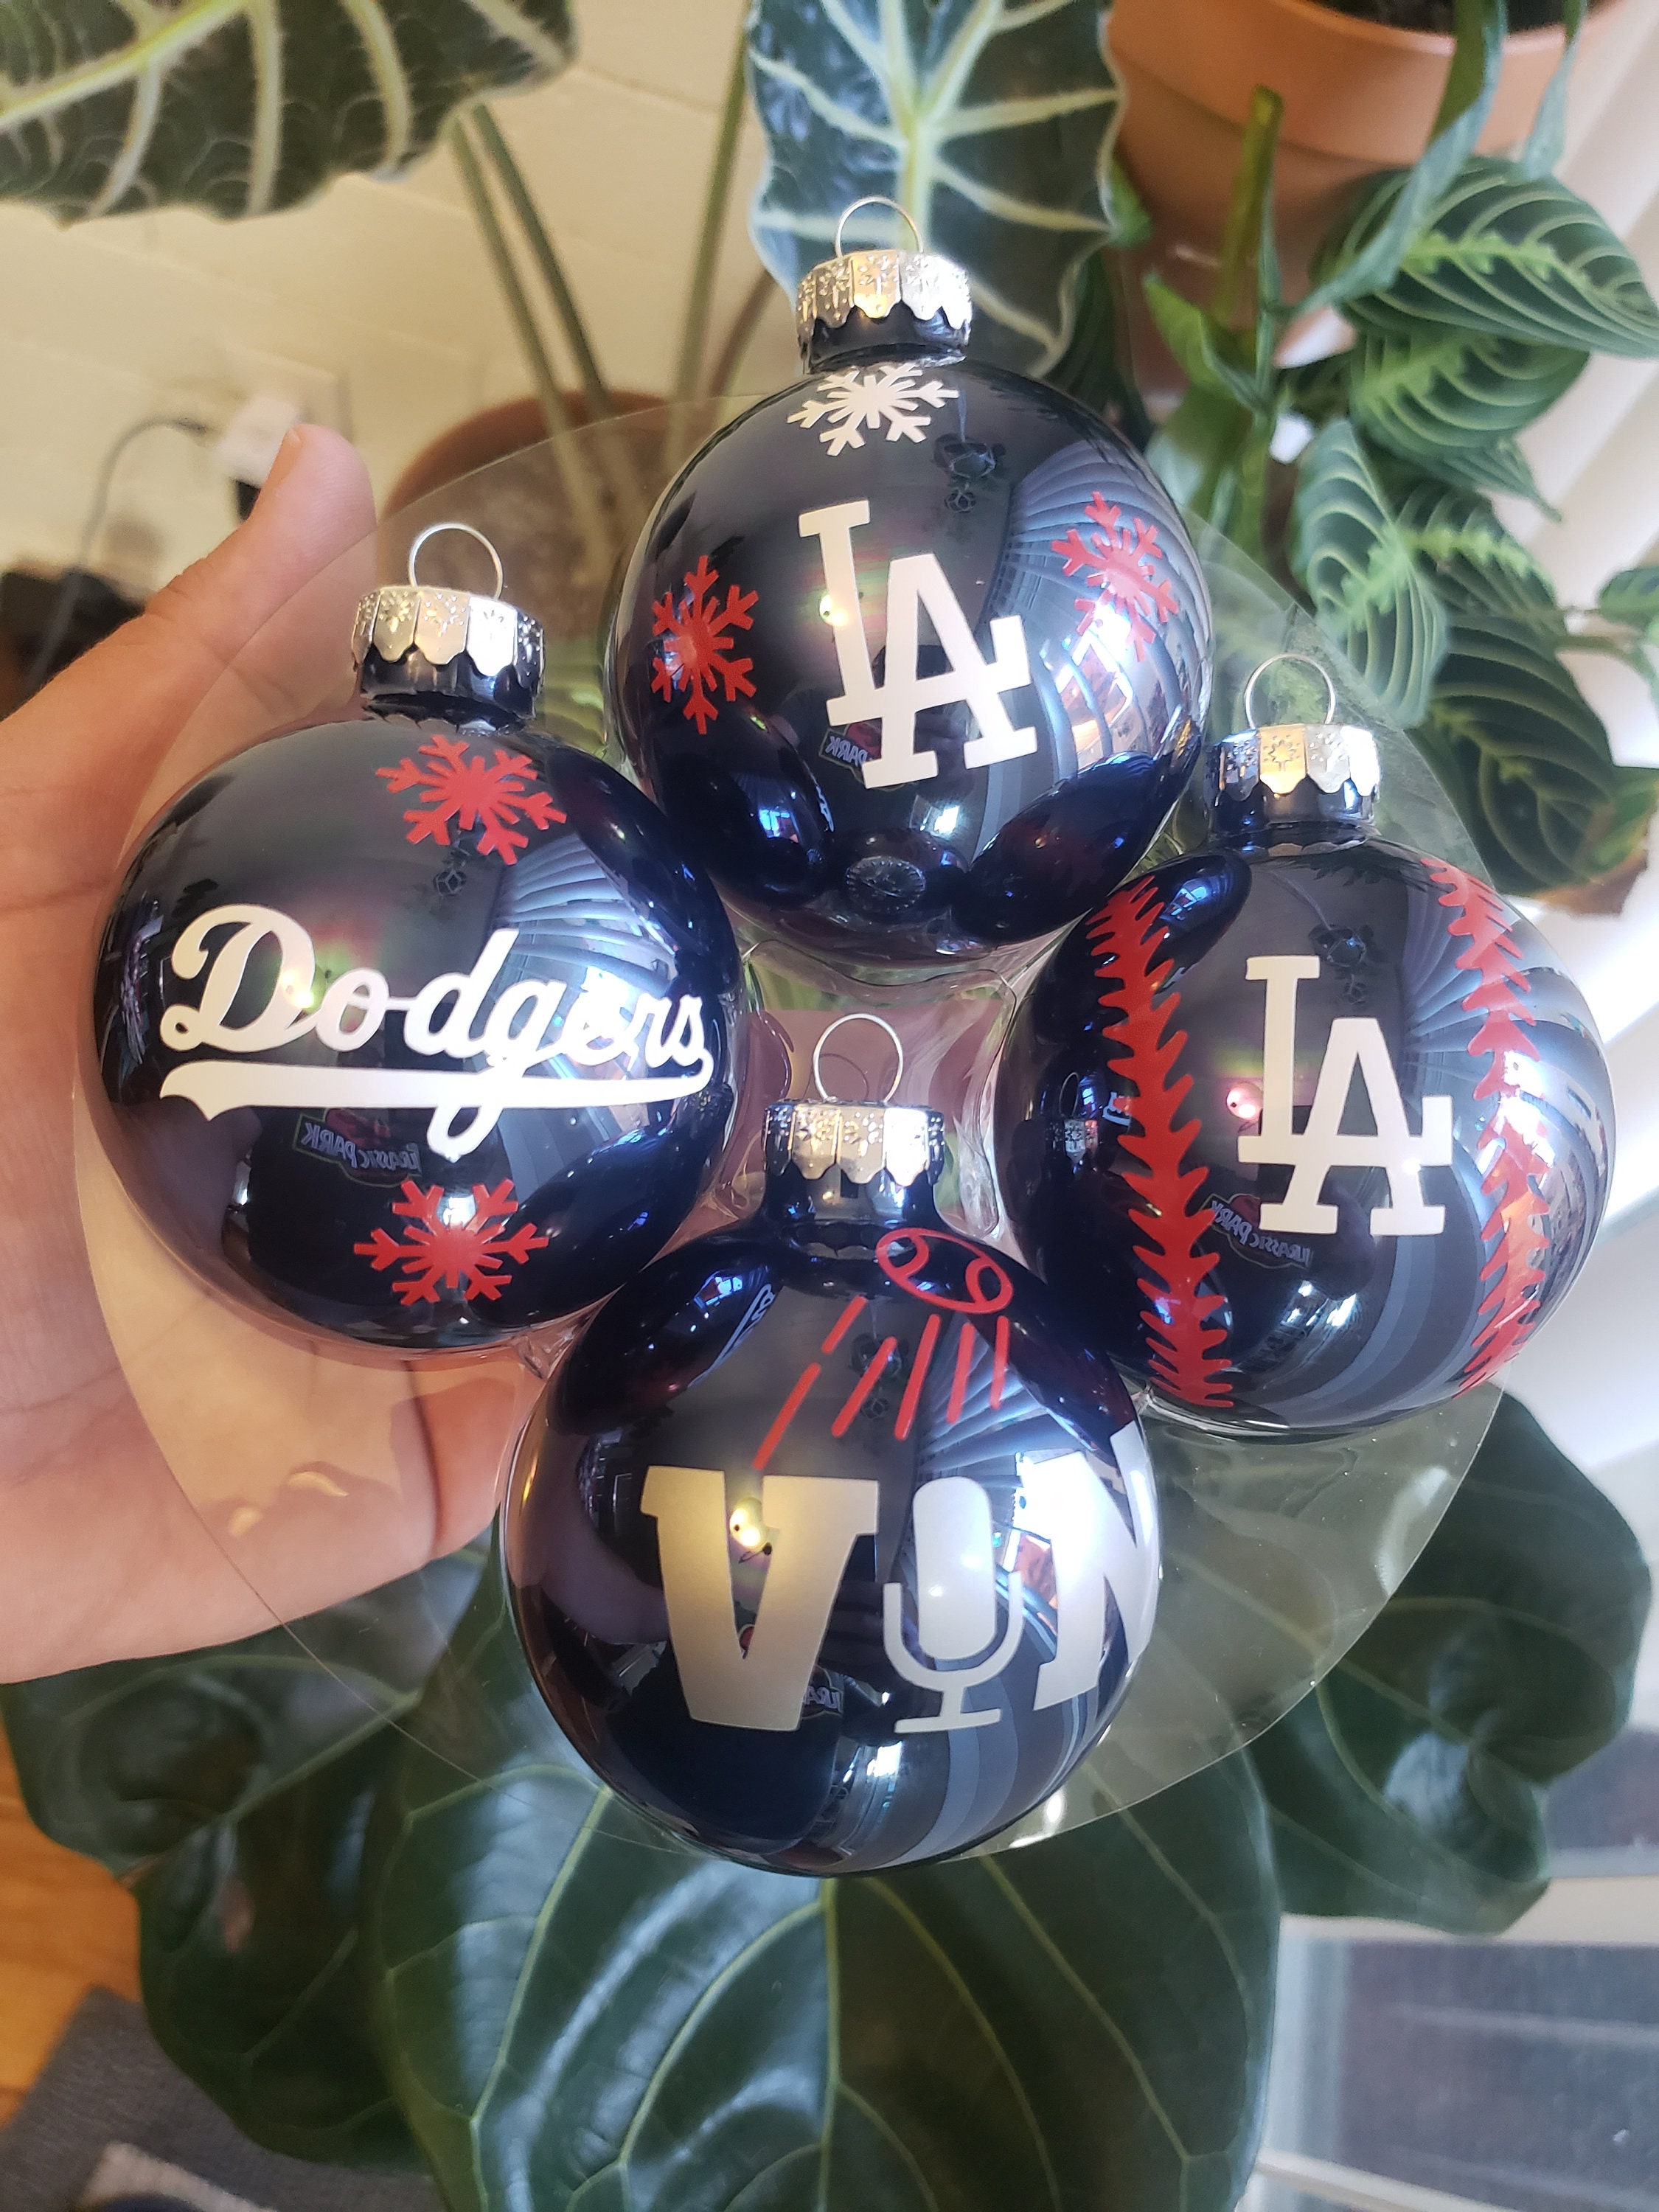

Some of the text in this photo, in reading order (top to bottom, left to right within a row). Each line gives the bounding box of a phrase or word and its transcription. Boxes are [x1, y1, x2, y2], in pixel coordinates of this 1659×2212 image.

[797, 499, 1037, 790] LA
[159, 904, 714, 1158] Dodgers
[1237, 955, 1454, 1237] LA
